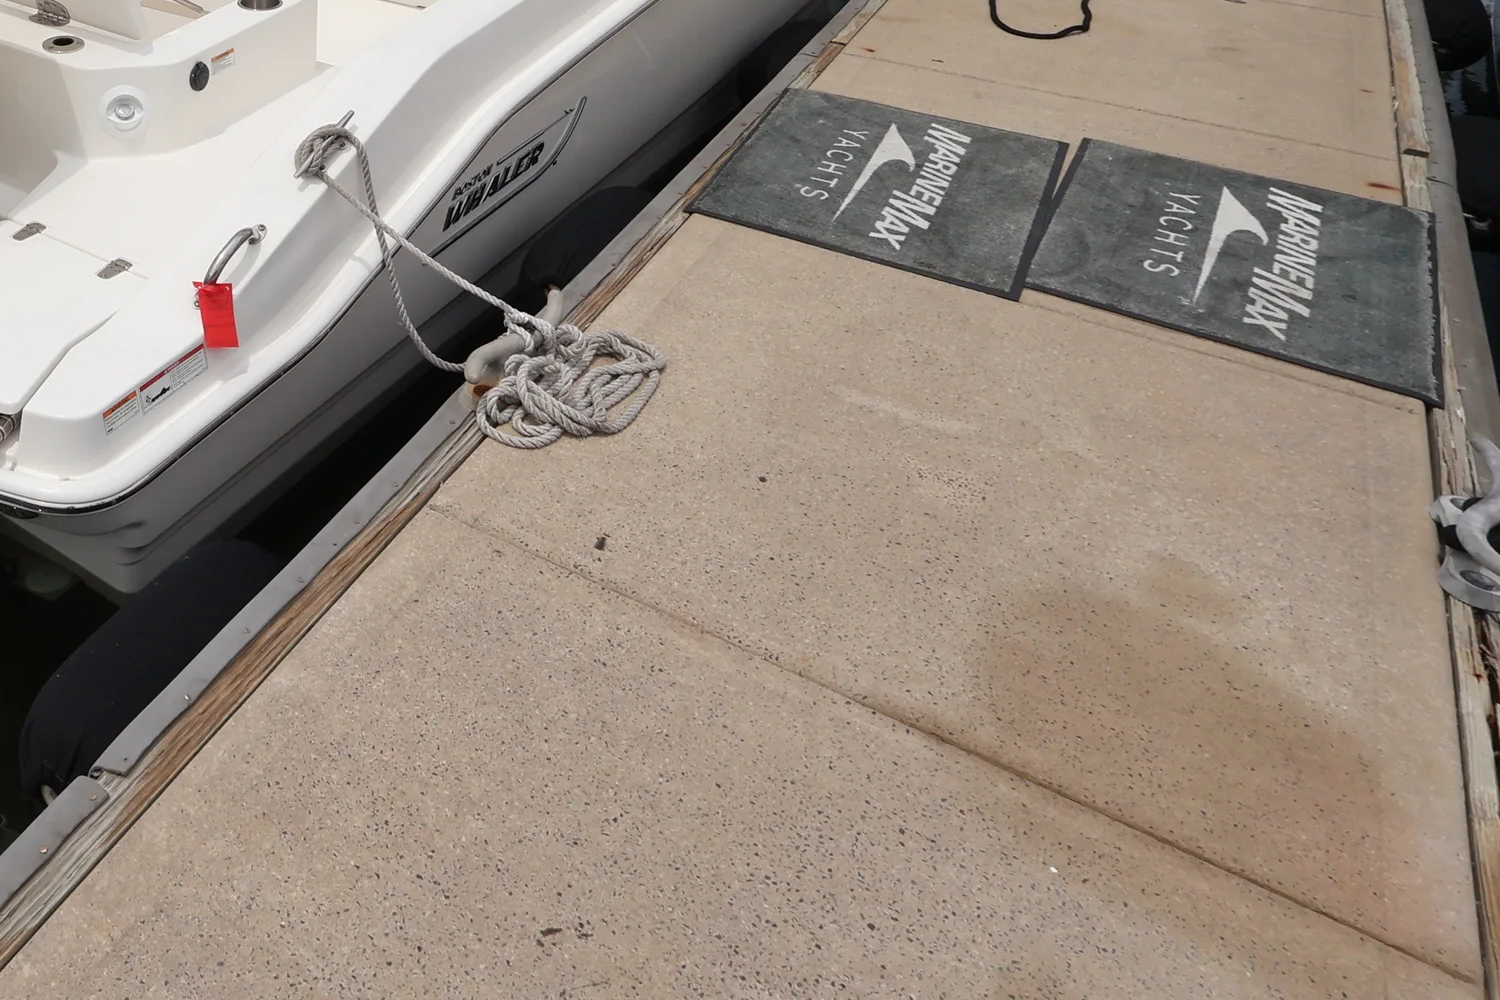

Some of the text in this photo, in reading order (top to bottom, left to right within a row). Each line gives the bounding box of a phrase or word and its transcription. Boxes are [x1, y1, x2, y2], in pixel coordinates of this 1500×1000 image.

[442, 140, 545, 232] WHALER
[451, 163, 494, 201] BOSTON
[800, 129, 870, 200] YACHTS
[1142, 191, 1202, 277] YACHTS
